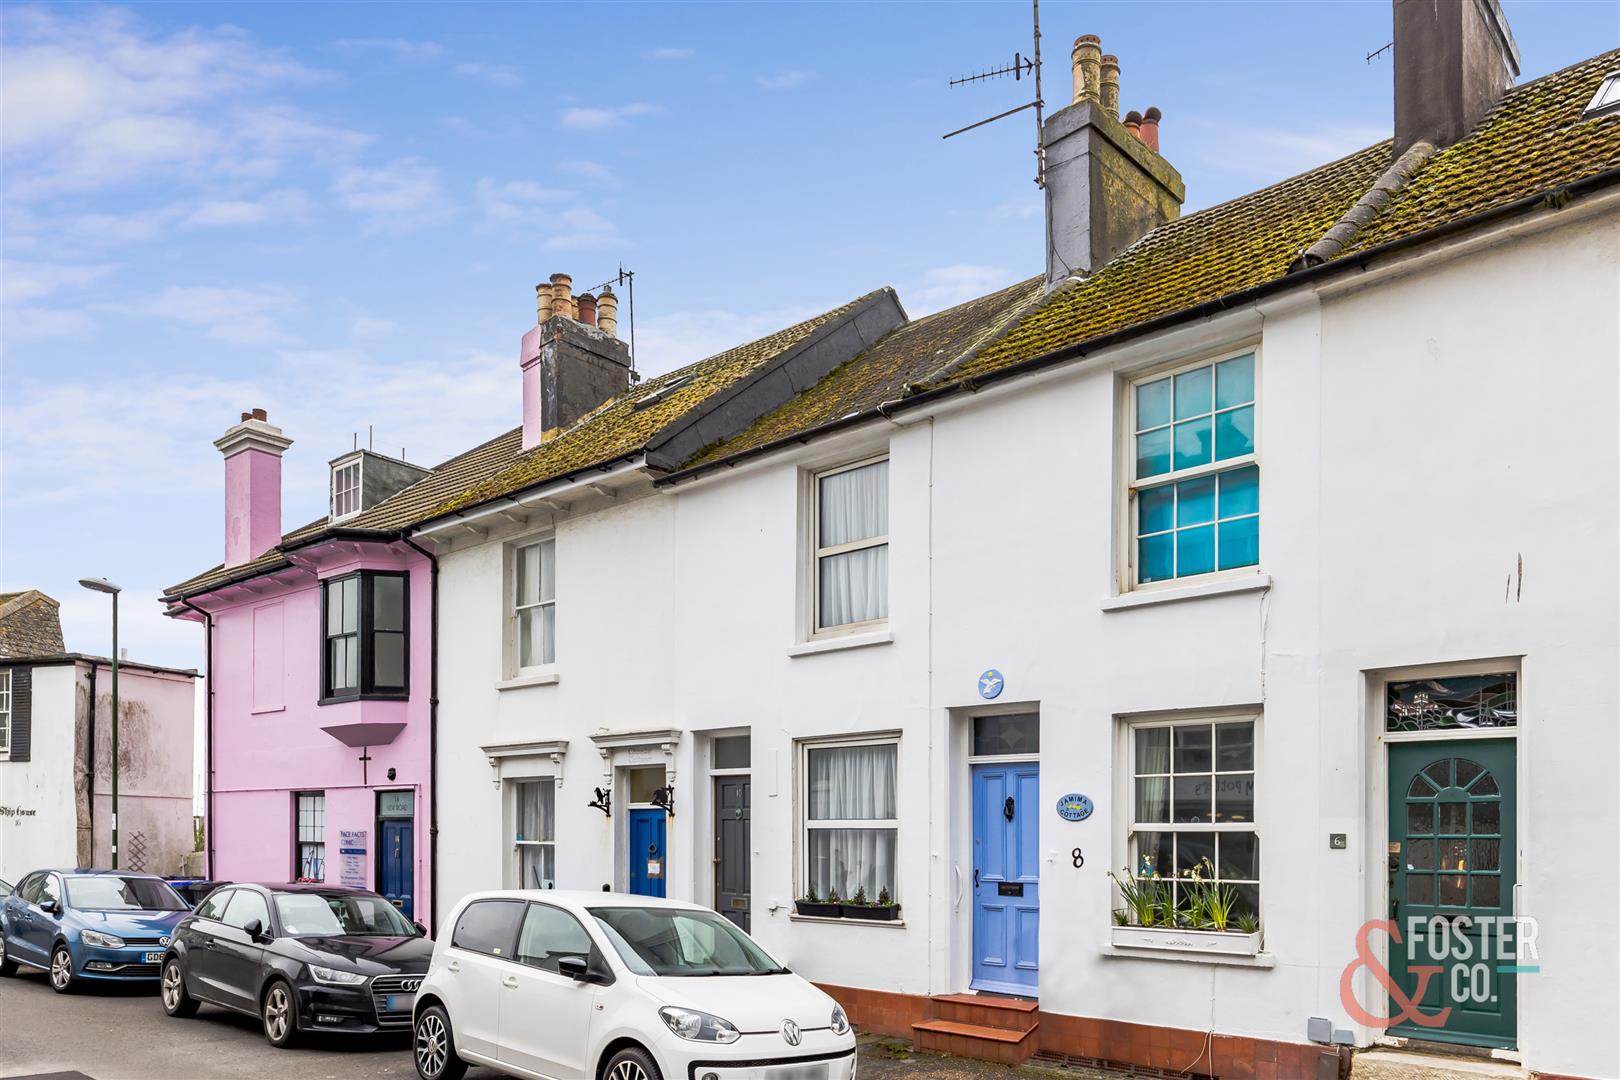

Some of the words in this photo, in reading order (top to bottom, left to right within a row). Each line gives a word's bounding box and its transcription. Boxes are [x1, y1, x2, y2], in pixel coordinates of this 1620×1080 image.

[1060, 796, 1087, 806] JAMIMA
[1060, 808, 1089, 818] COTTAGE
[1334, 836, 1341, 846] 6
[1071, 847, 1084, 869] 8
